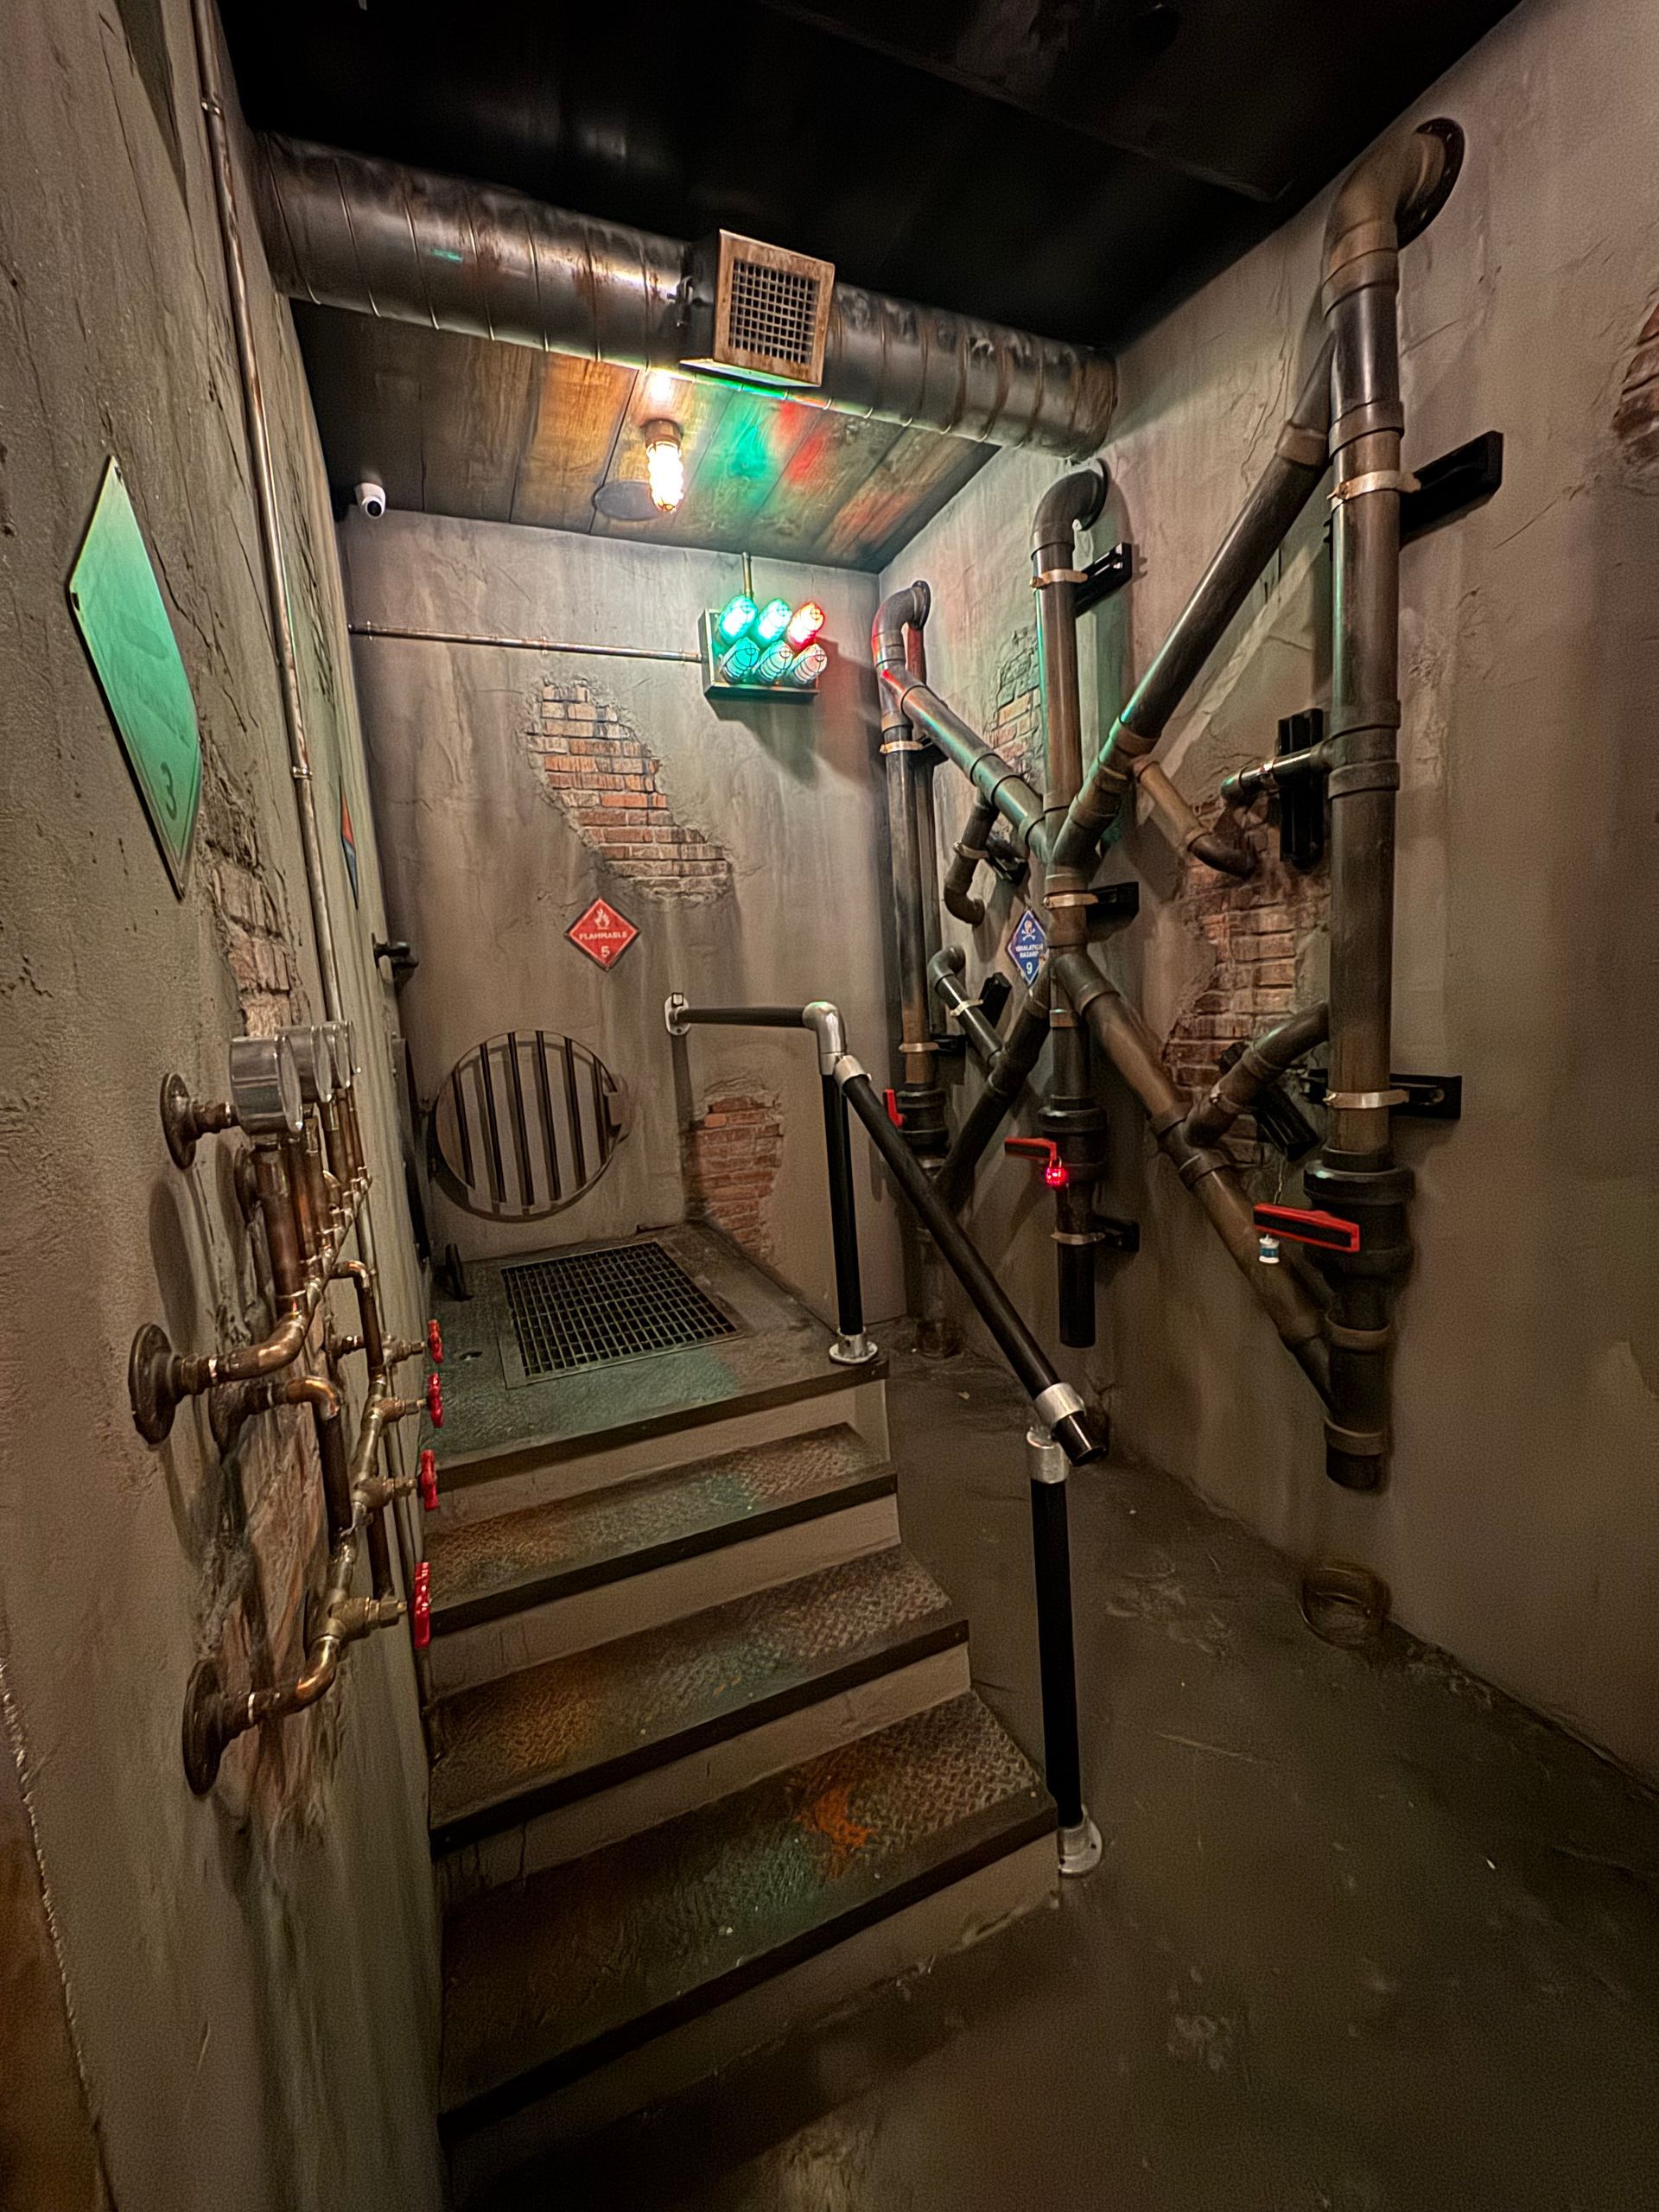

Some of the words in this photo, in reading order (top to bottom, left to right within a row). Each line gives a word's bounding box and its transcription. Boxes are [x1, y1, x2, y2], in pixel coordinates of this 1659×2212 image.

[160, 761, 178, 821] 3
[579, 931, 628, 941] FLAMMABLE
[1026, 962, 1033, 975] 9
